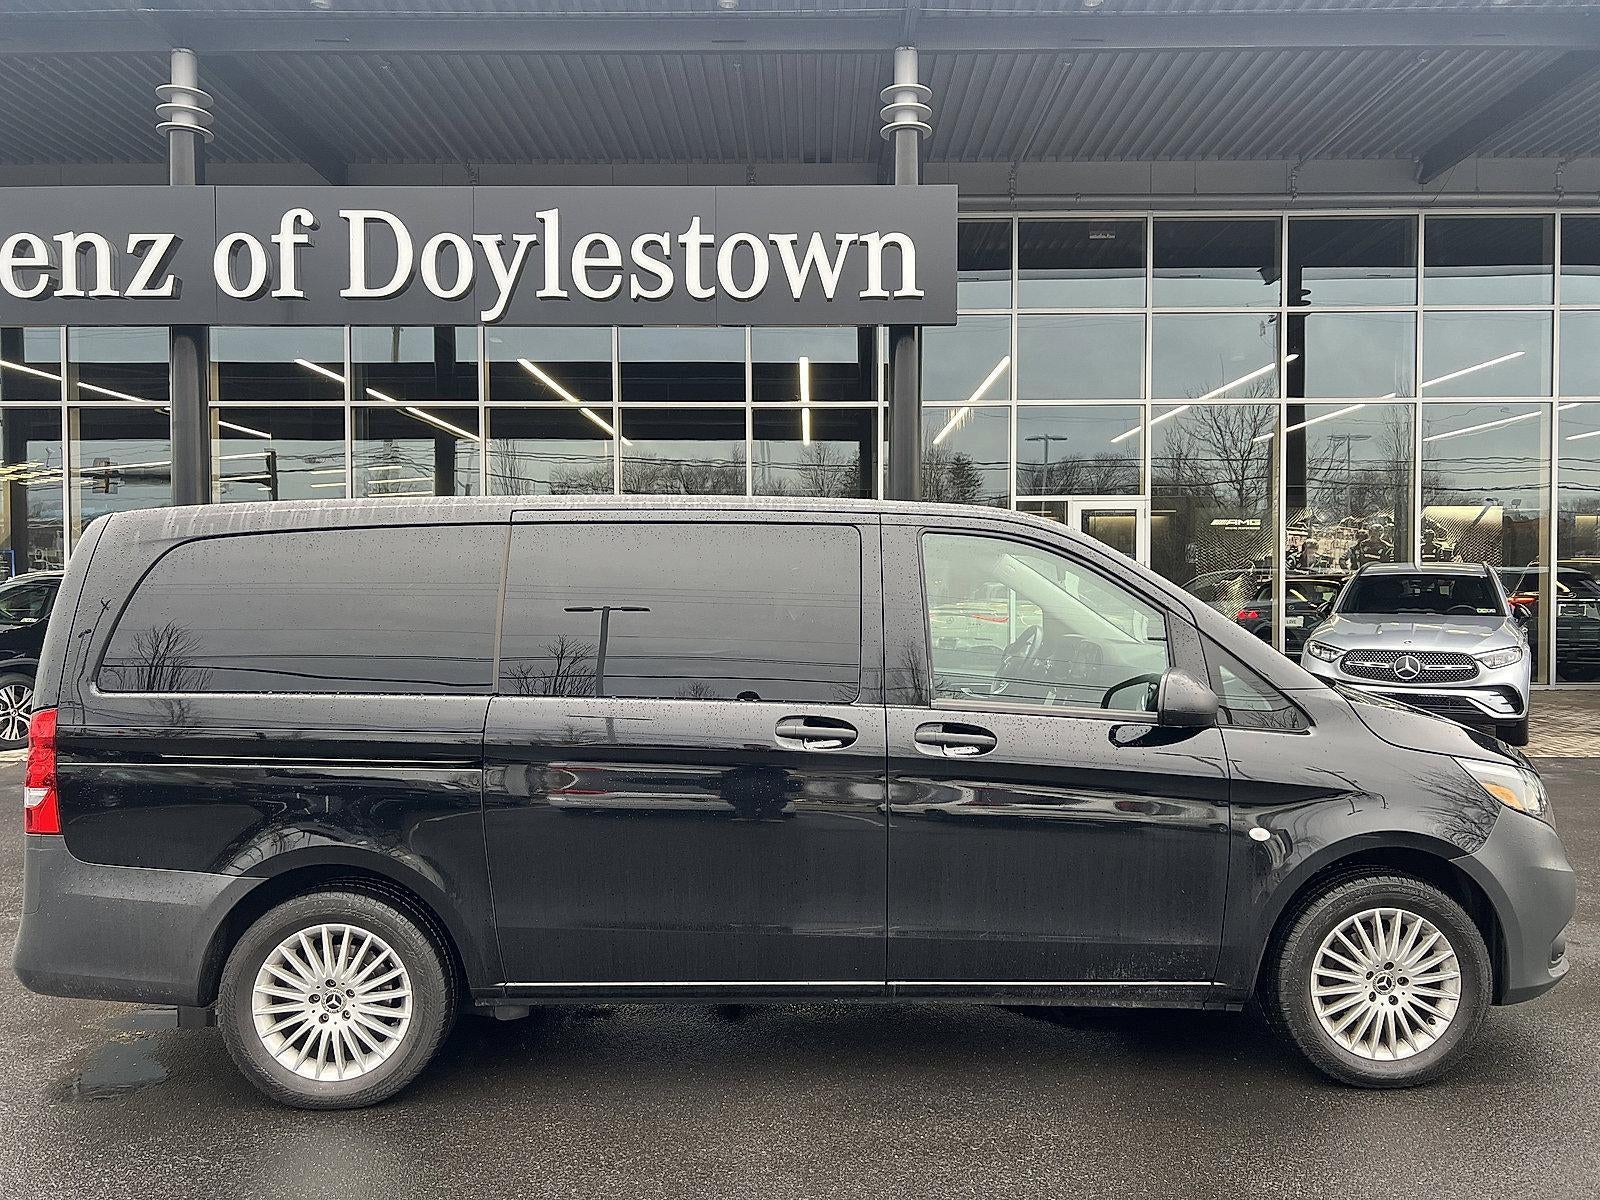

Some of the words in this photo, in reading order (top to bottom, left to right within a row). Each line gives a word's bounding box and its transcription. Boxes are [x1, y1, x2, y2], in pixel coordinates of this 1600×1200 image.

[0, 232, 175, 298] enz
[213, 208, 315, 298] of
[339, 207, 925, 322] Doylestown
